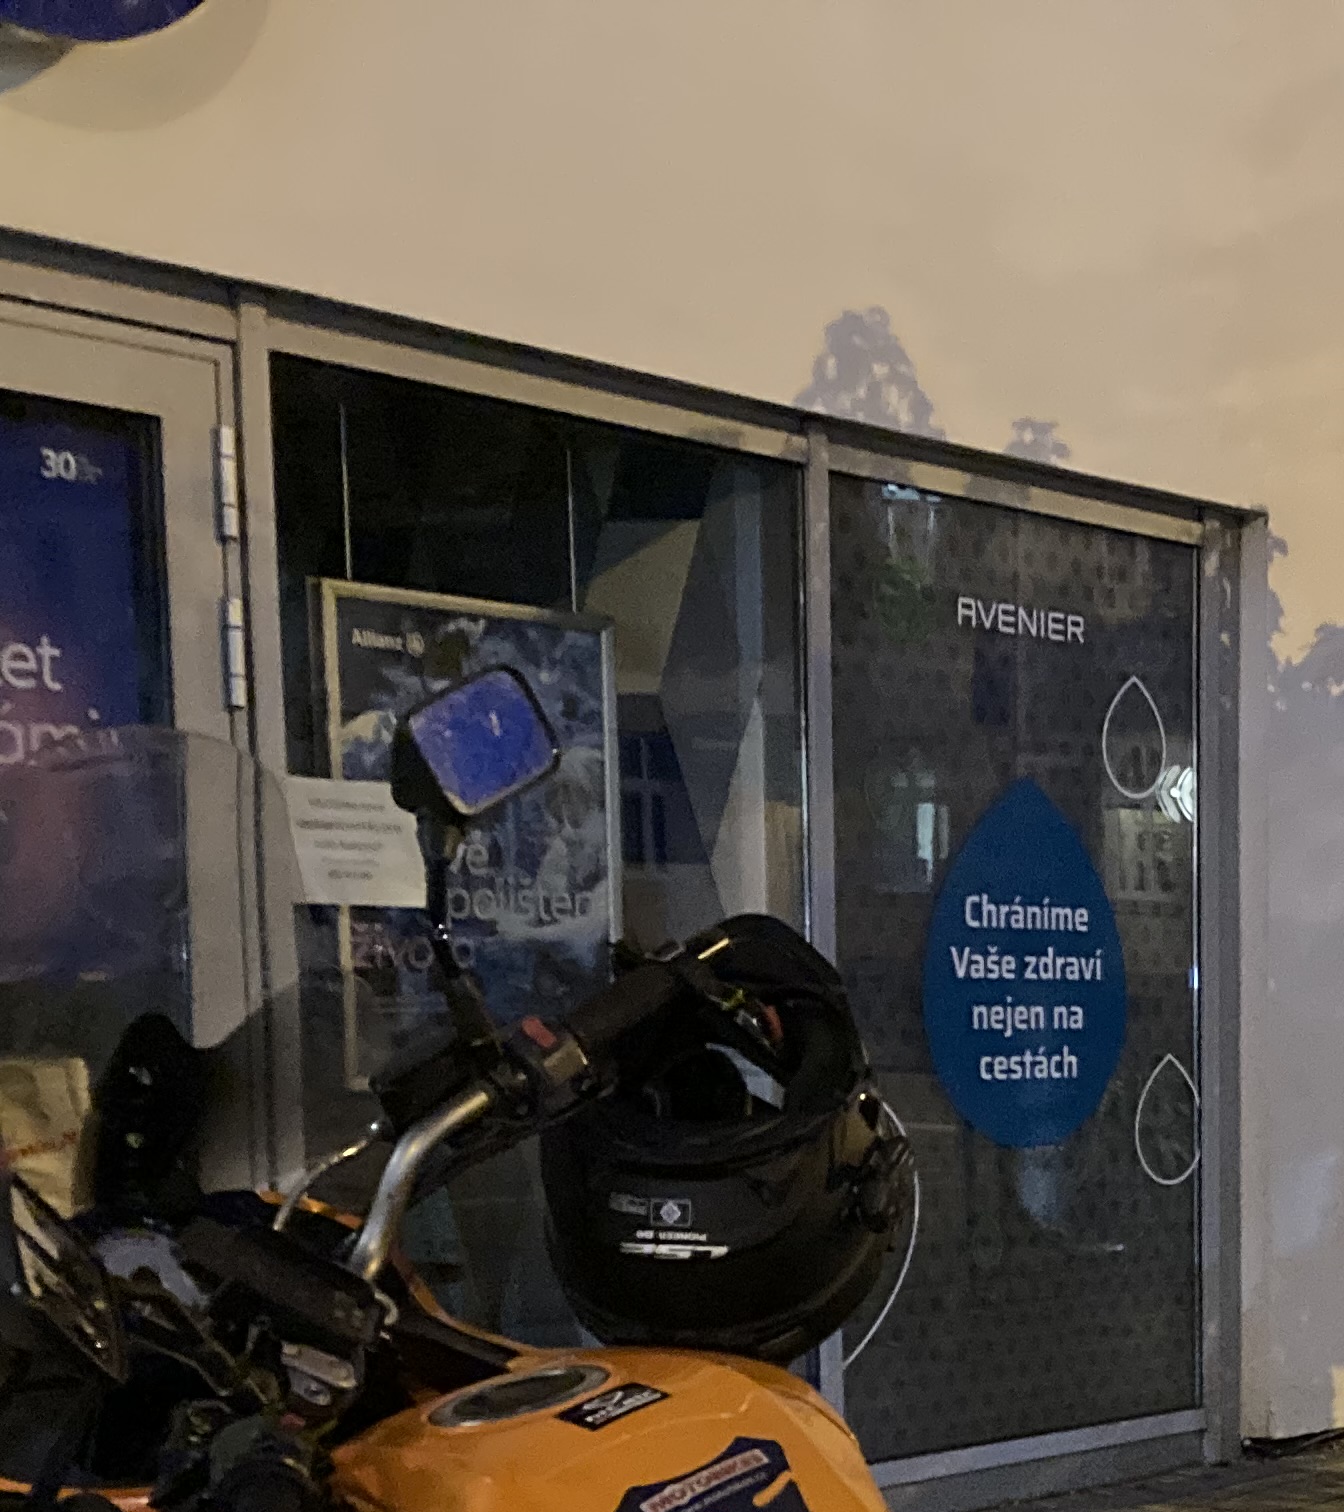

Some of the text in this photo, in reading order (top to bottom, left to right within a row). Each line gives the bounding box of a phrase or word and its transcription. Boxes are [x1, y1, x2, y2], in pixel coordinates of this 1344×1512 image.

[40, 447, 77, 481] 30
[957, 596, 1086, 644] AVENIER
[964, 893, 1090, 932] Chráníme
[950, 945, 1104, 981] Vaše zdraví
[972, 996, 1084, 1038] nejen na
[979, 1045, 1079, 1081] cestách
